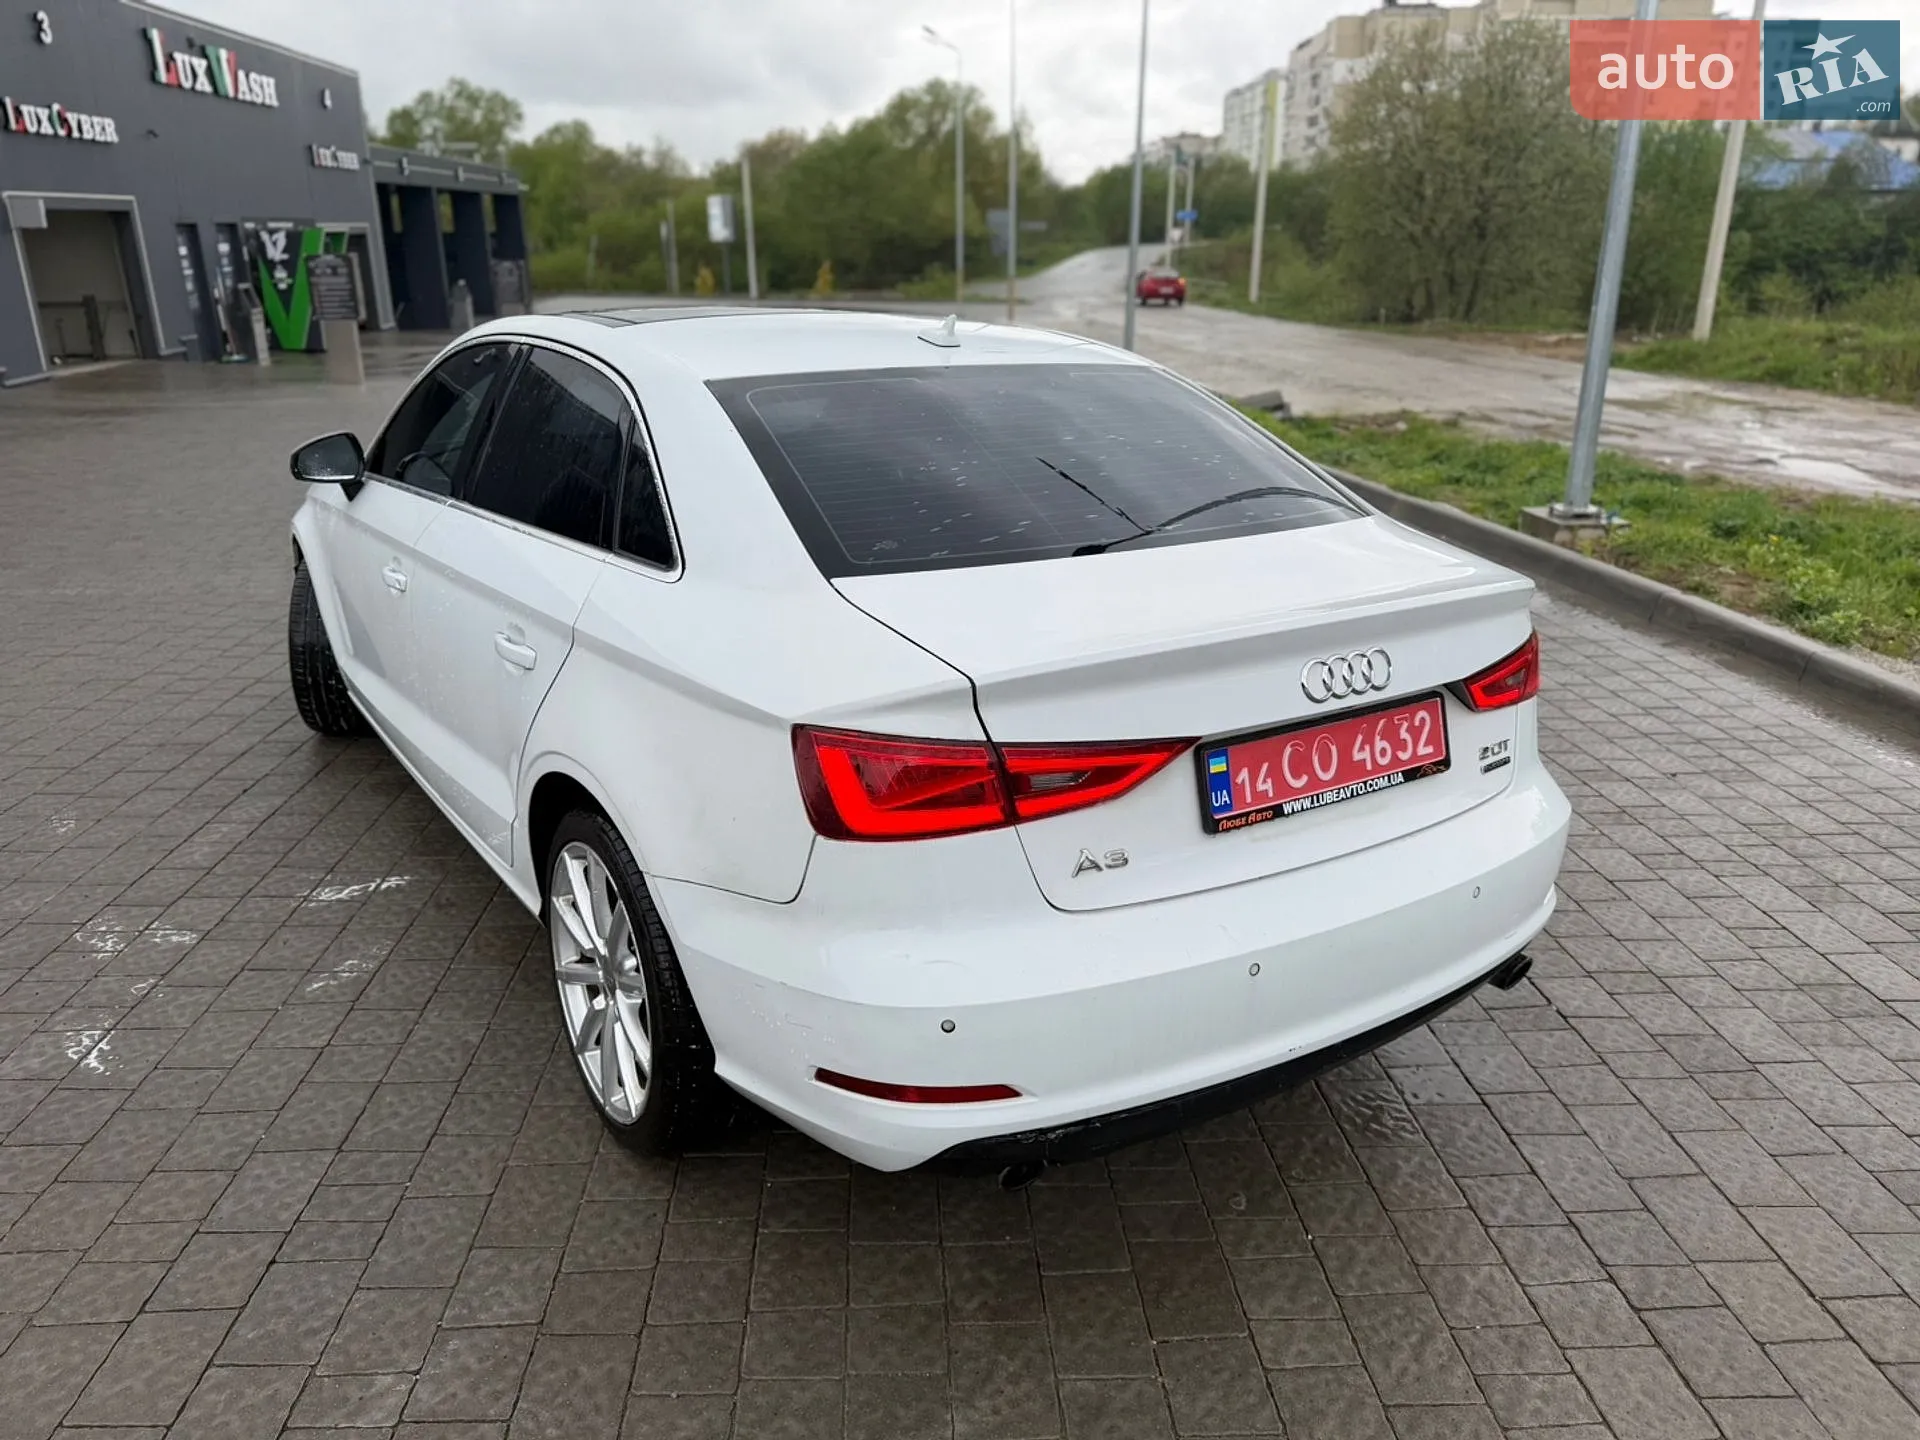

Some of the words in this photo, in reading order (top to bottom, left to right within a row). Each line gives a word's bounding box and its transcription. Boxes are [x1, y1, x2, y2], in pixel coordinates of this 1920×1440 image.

[37, 10, 53, 44] 3
[1235, 761, 1273, 803] 14
[1282, 733, 1338, 789] CO
[1352, 709, 1434, 771] 4632
[1212, 790, 1231, 808] UA
[1282, 772, 1405, 816] WWW.LUBEAVTO.COM.UA
[1071, 848, 1129, 879] A3
